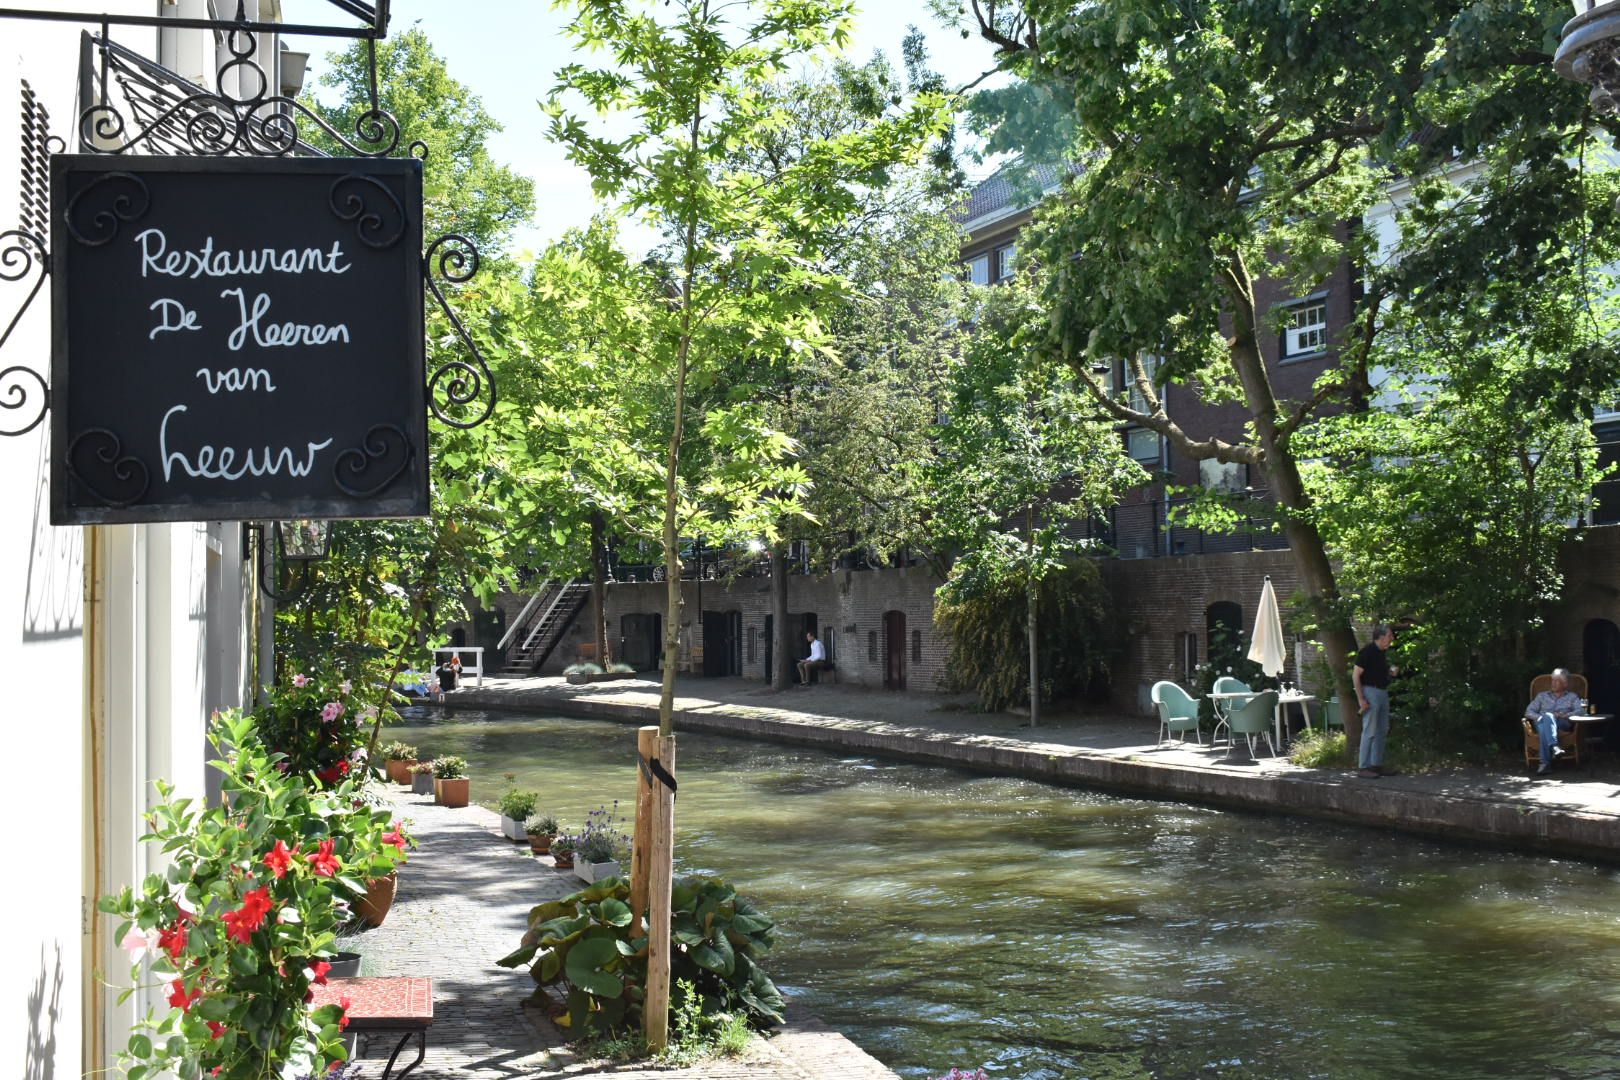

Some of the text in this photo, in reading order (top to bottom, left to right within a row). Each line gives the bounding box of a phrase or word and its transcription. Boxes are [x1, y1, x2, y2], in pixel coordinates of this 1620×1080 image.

[134, 228, 352, 279] Restaurant
[149, 287, 350, 351] De Heeren
[196, 367, 277, 394] van
